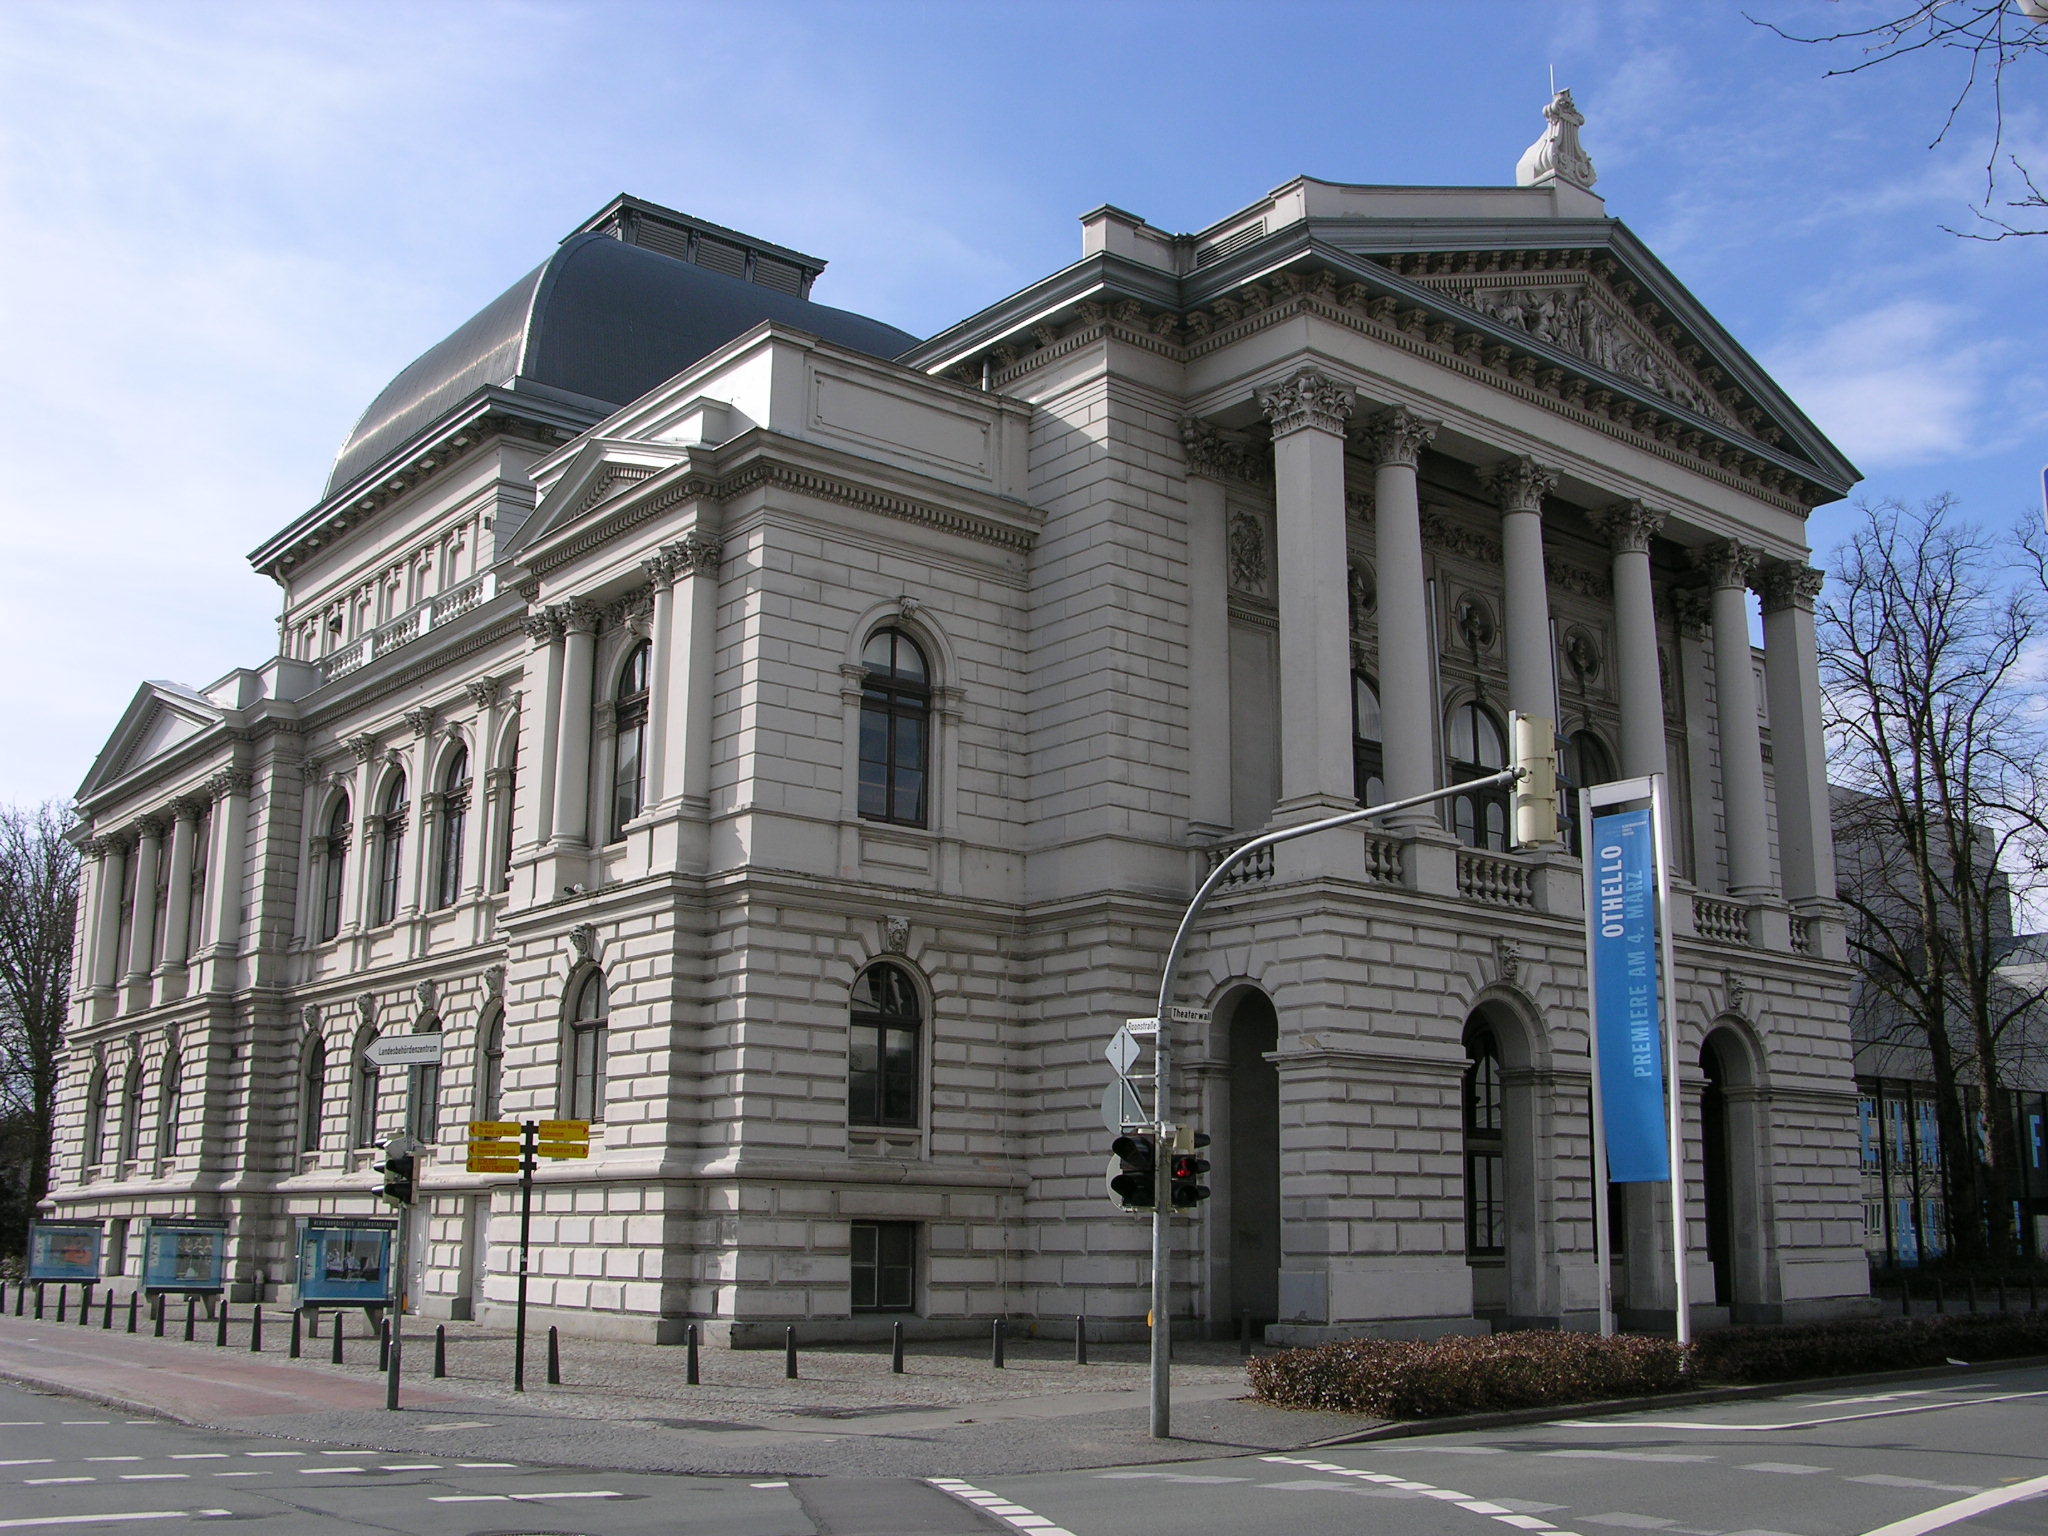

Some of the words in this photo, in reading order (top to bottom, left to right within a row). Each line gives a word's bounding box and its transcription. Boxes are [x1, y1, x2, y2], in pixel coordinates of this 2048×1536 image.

[1601, 845, 1624, 938] OTHELLO
[1623, 869, 1644, 919] MÄRZ
[1627, 926, 1645, 943] 4.
[1627, 950, 1646, 976] AM
[1173, 1008, 1211, 1021] Theaterwall
[1628, 984, 1652, 1078] PREMIERE
[378, 1045, 438, 1056] Landesbehördenzentrum
